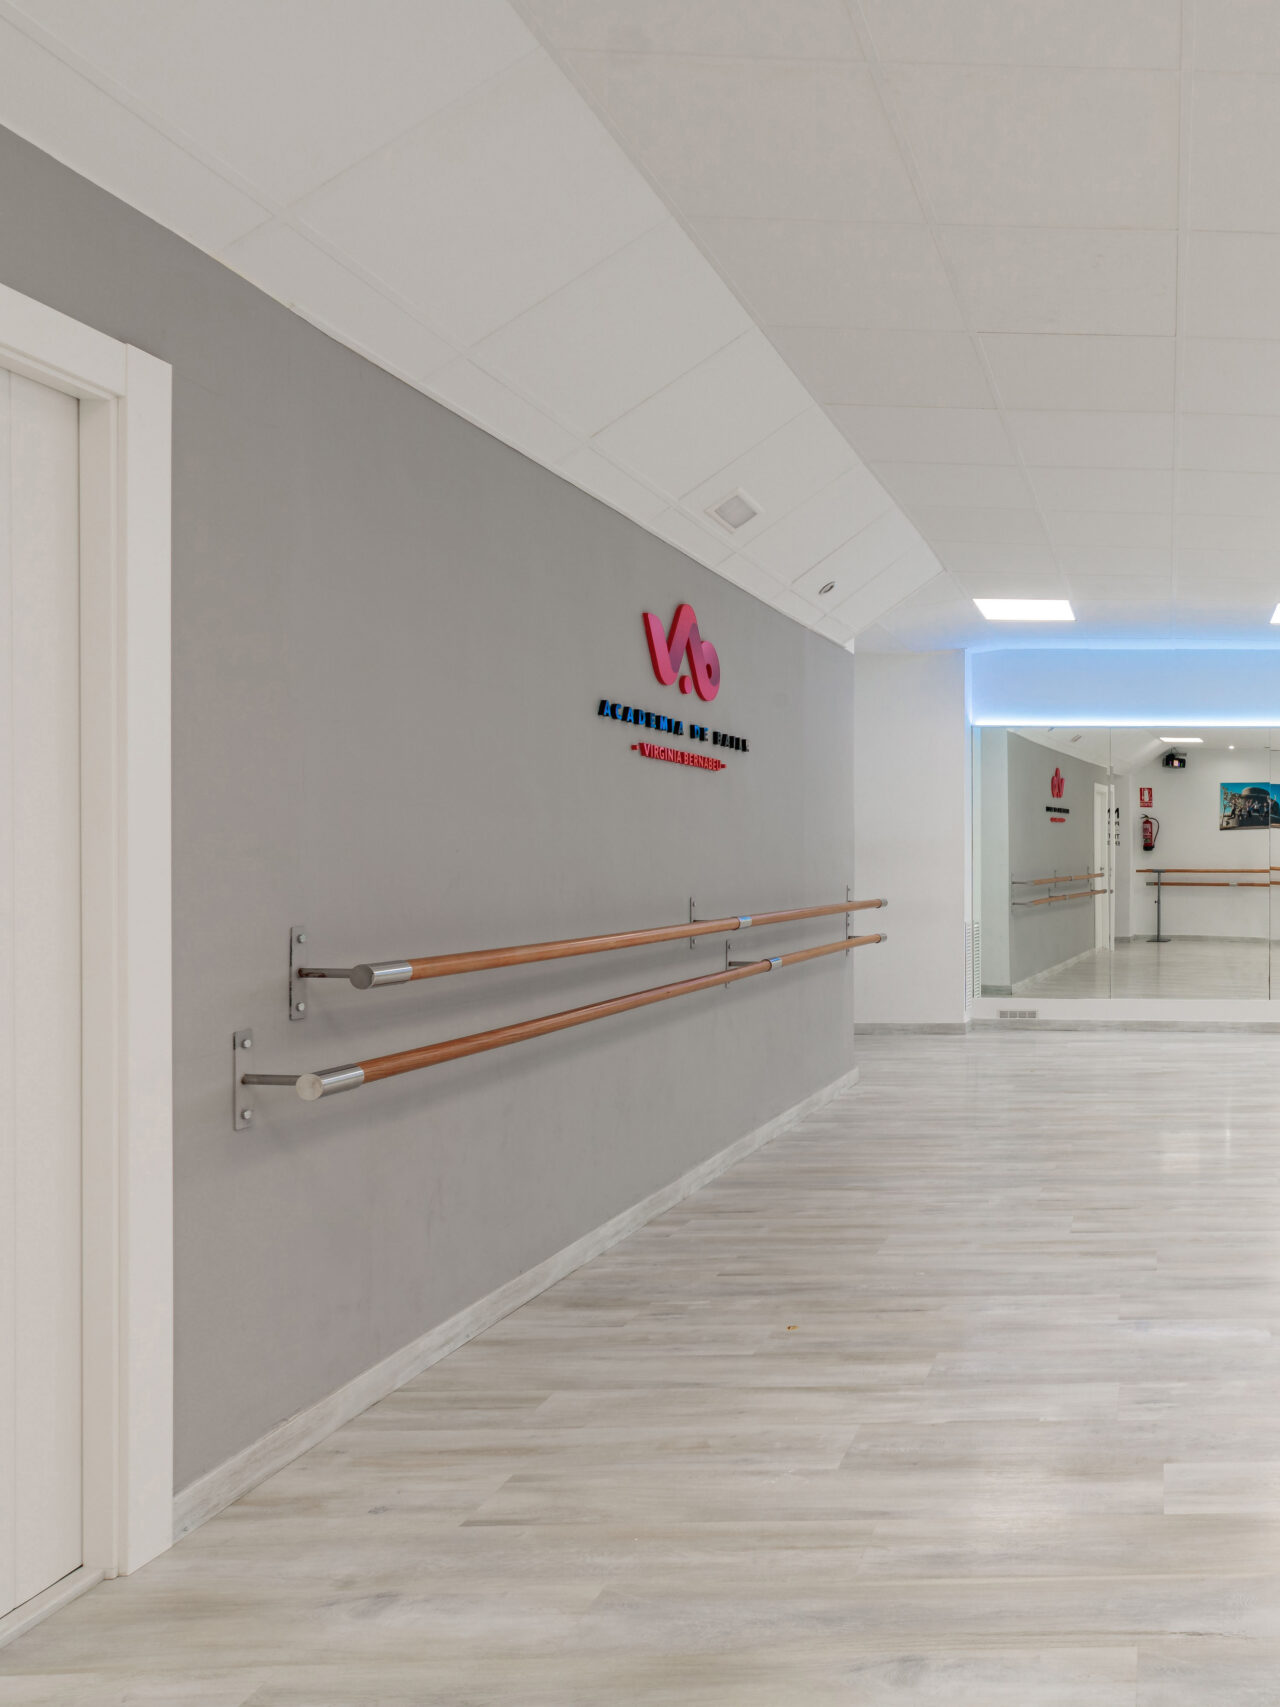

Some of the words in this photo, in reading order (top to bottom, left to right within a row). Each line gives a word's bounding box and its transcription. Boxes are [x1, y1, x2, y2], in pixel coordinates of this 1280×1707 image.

[598, 699, 684, 736] ACADEMIA
[690, 724, 709, 741] DE
[639, 742, 683, 764] VIRGINIA
[683, 751, 722, 771] BERNABEU
